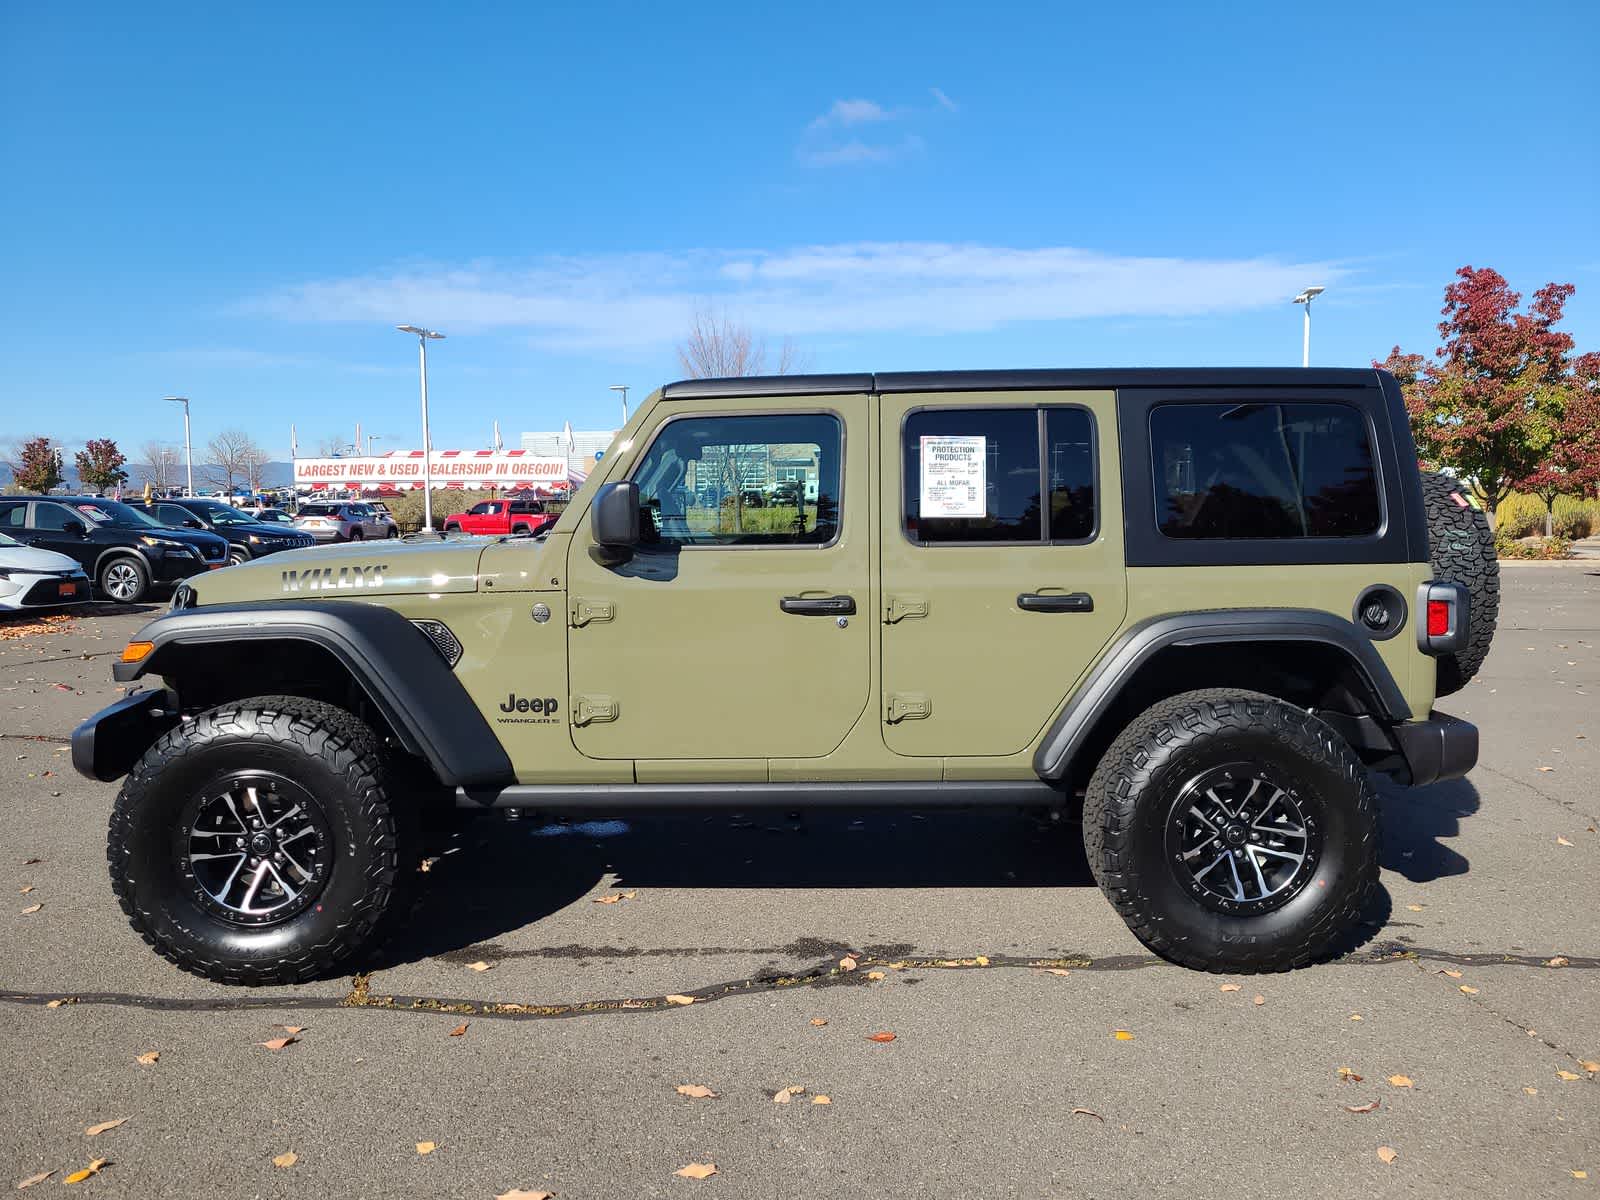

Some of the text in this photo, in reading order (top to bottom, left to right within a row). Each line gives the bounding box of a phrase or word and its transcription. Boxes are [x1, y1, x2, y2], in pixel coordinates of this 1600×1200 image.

[298, 464, 346, 476] LARGEST
[349, 464, 375, 476] NEW
[377, 463, 386, 476] &
[389, 463, 419, 476] USED
[495, 463, 508, 475] IN
[511, 463, 564, 475] OREGON!
[282, 565, 389, 592] WILLYS
[499, 693, 559, 717] Jeep
